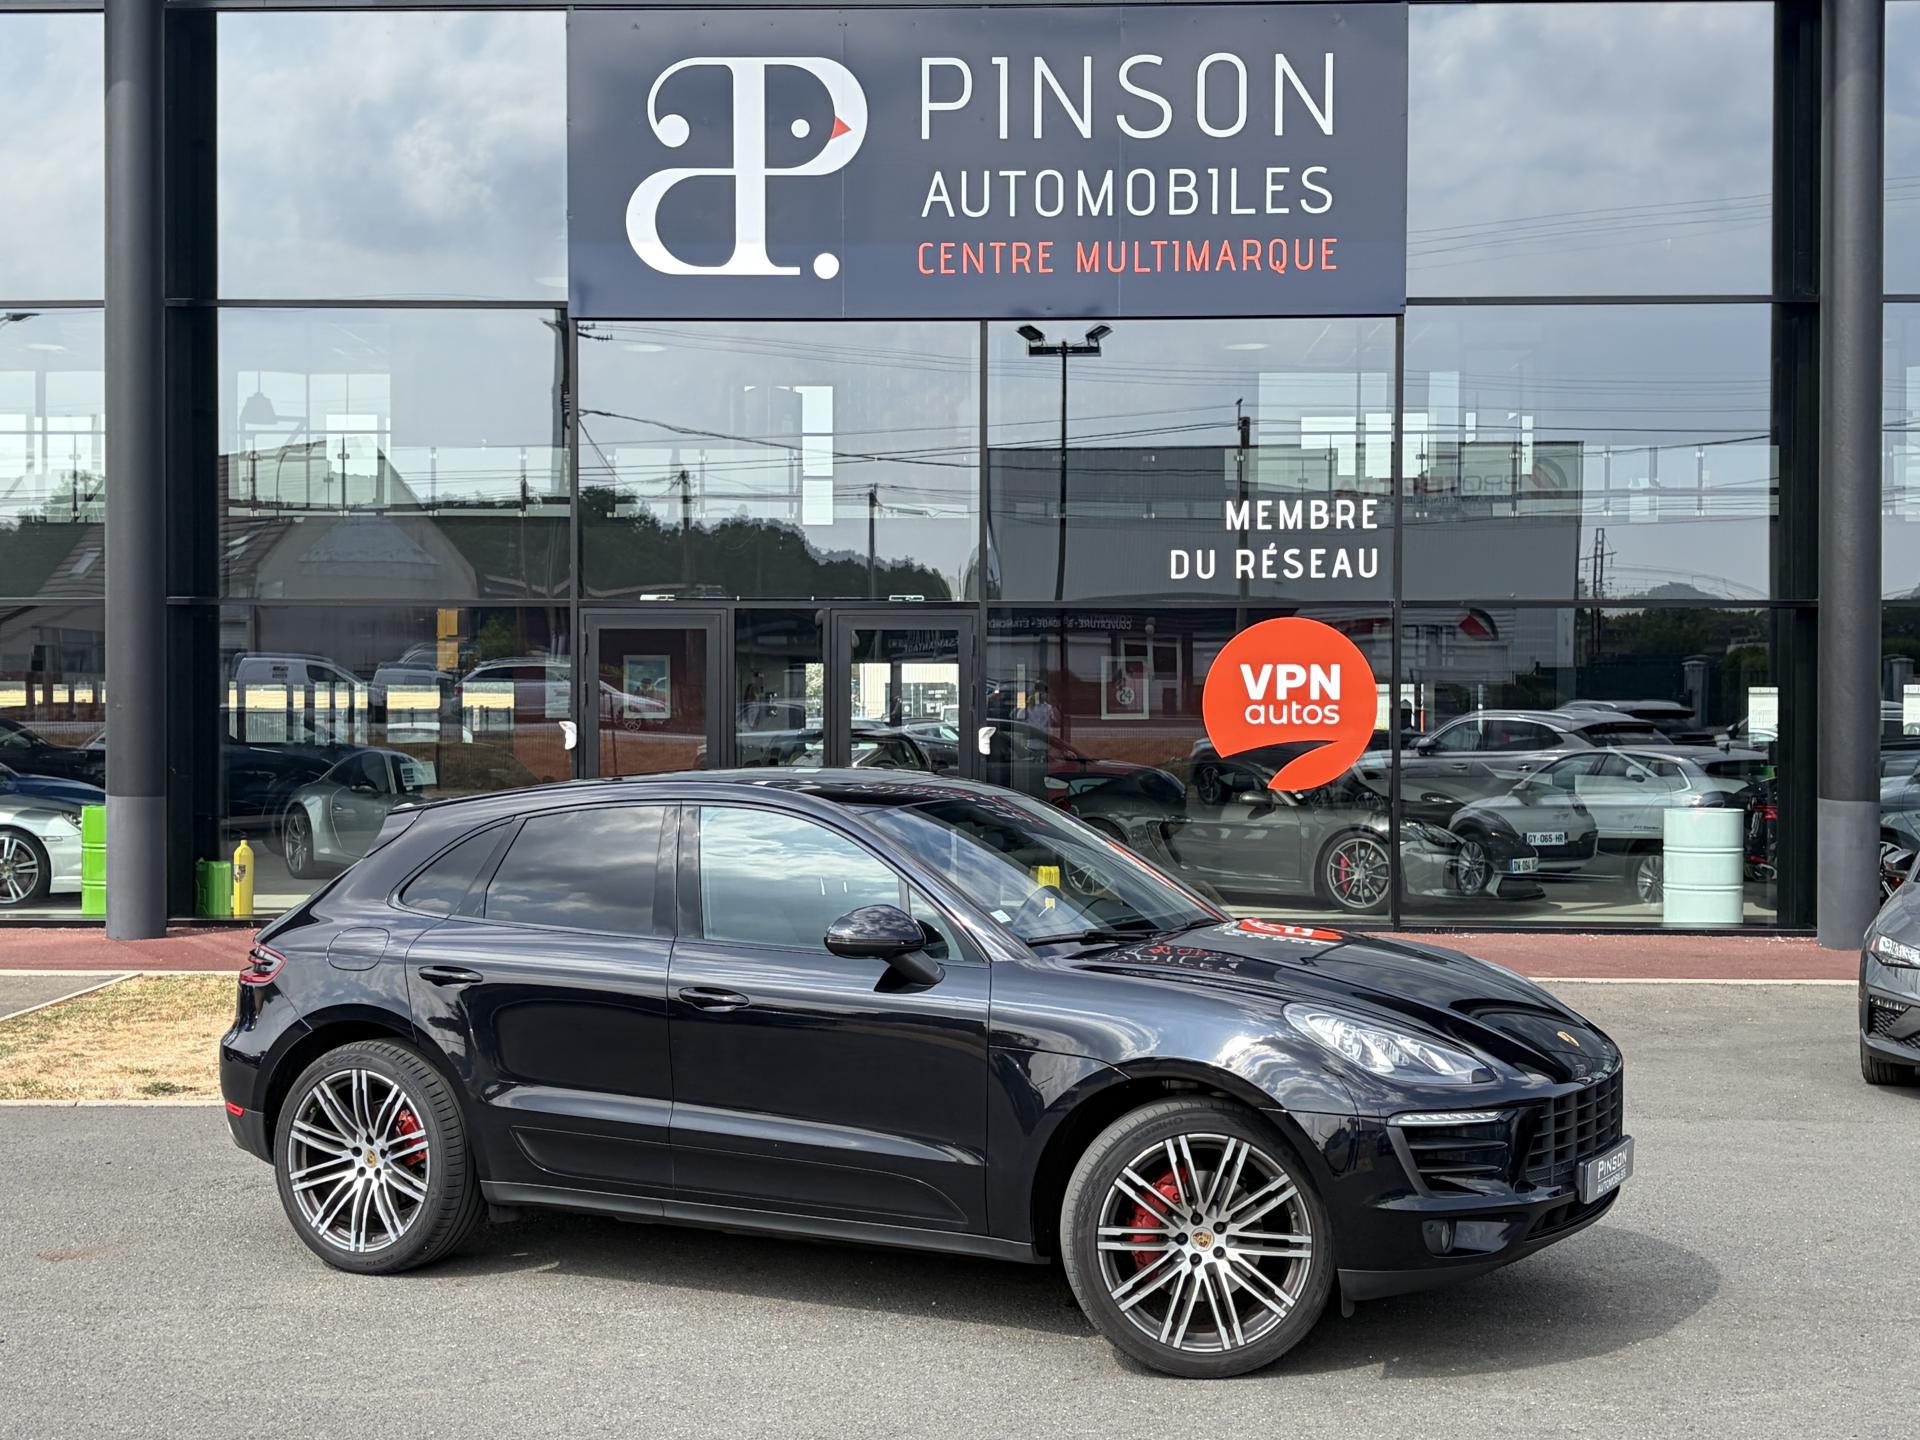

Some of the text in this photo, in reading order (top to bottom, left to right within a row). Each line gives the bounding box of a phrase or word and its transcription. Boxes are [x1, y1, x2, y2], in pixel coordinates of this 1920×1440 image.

[921, 52, 1334, 140] PINSON
[921, 166, 1333, 217] AUTOMOBILES
[918, 238, 1339, 275] CENTRE MULTIMARQUE
[1226, 499, 1378, 530] MEMBRE
[1170, 543, 1378, 580] DU RÉSEAU
[1240, 664, 1341, 700] VPN
[1245, 702, 1340, 725] autos
[1132, 1117, 1184, 1142] KUMHO
[1598, 1149, 1628, 1180] PINSON
